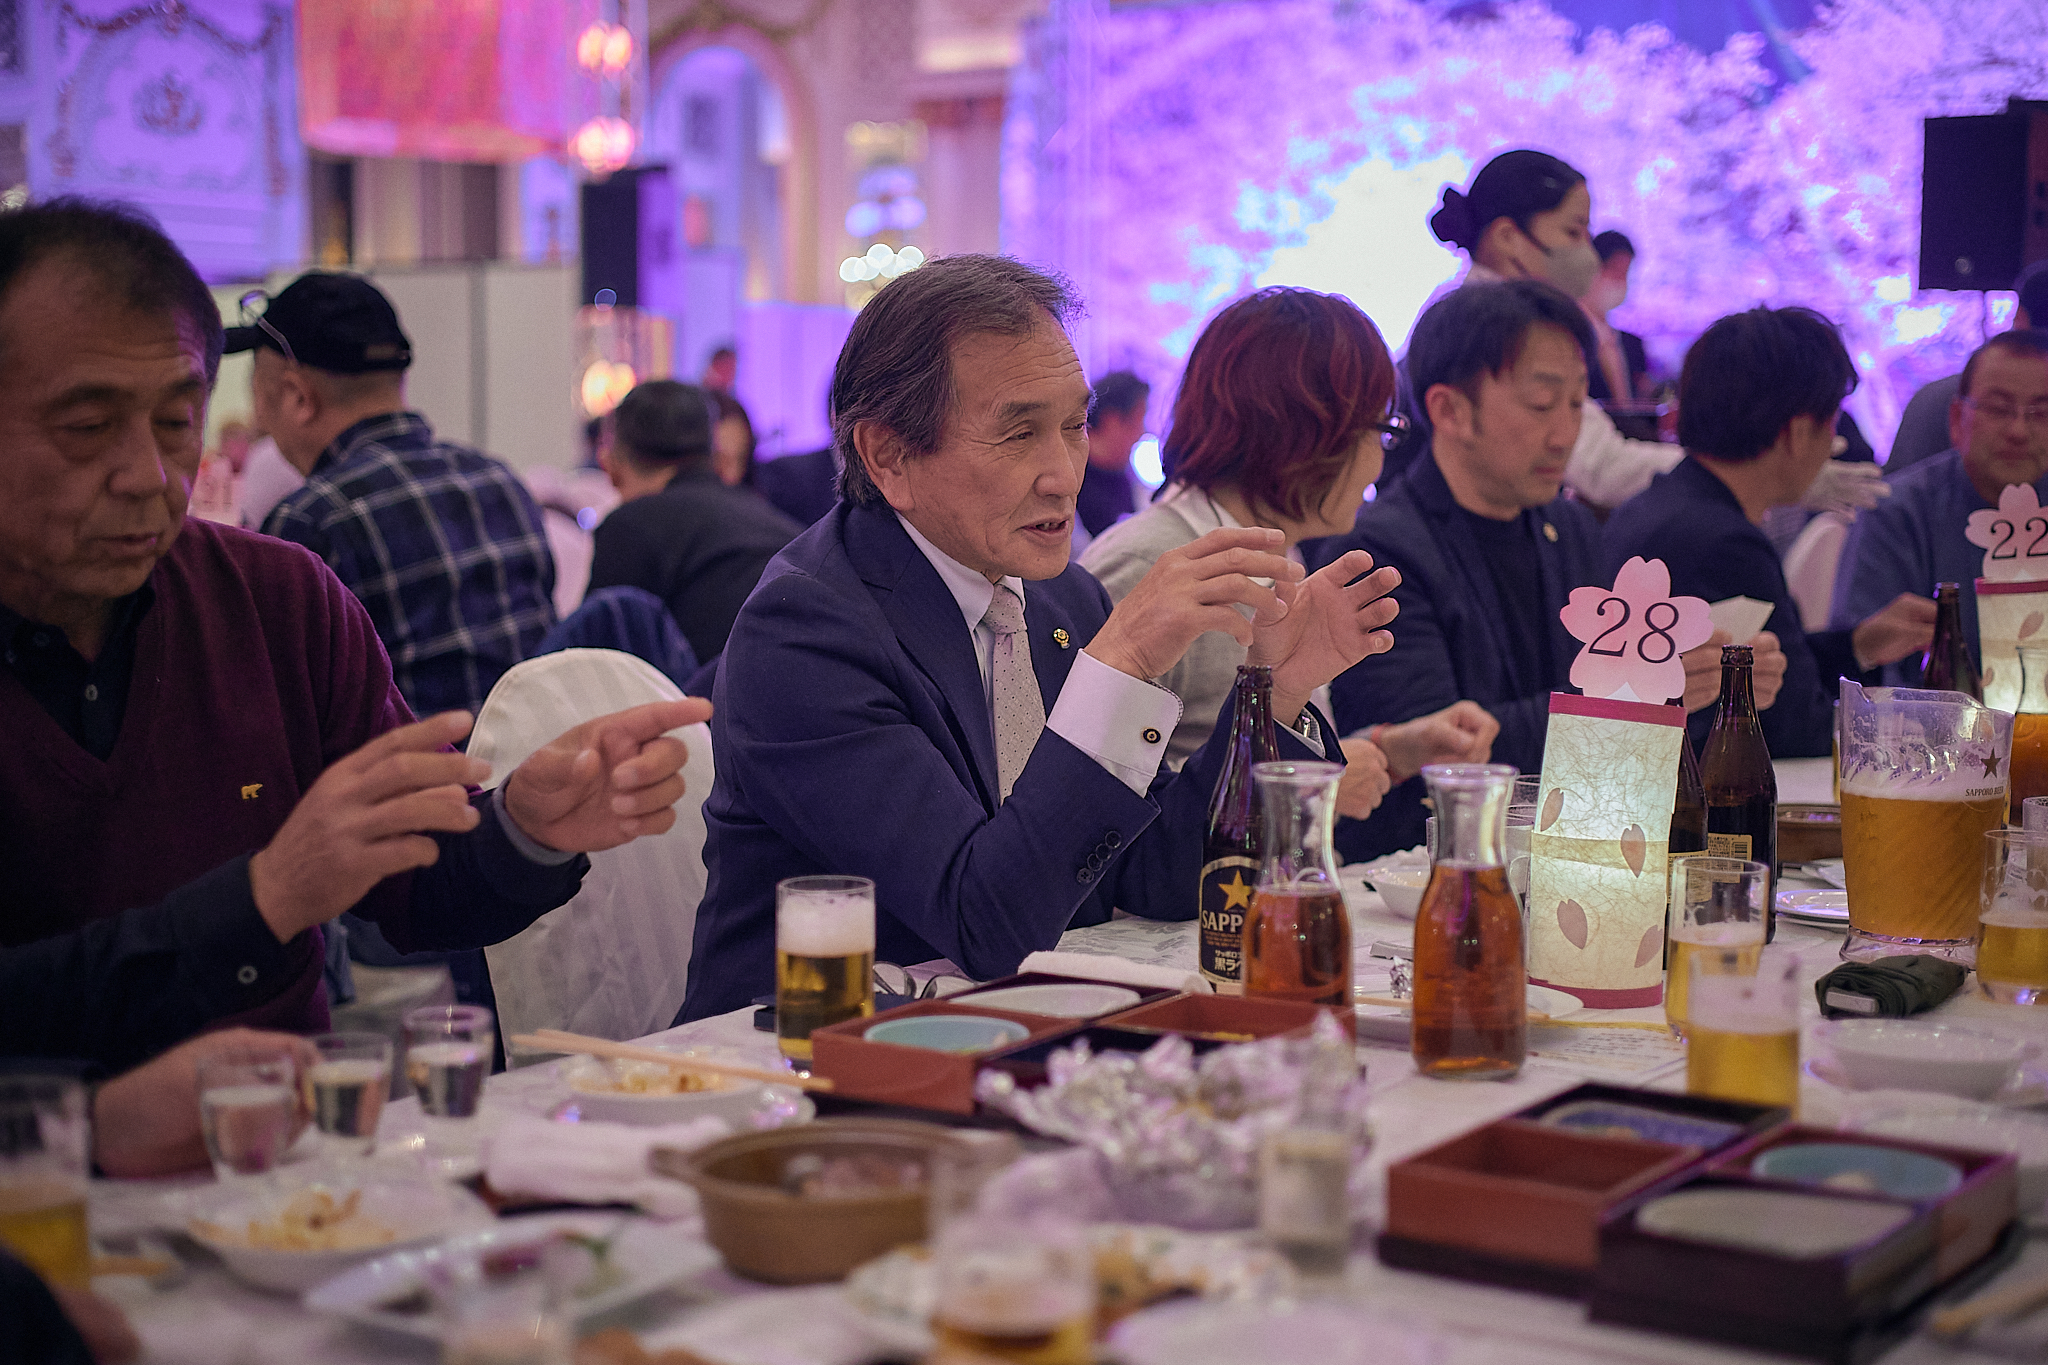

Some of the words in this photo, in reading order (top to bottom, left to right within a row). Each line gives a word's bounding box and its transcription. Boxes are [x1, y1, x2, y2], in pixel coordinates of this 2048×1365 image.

[1991, 517, 2048, 559] 22
[1588, 597, 1679, 664] 28
[1965, 788, 1993, 797] SAPPORO
